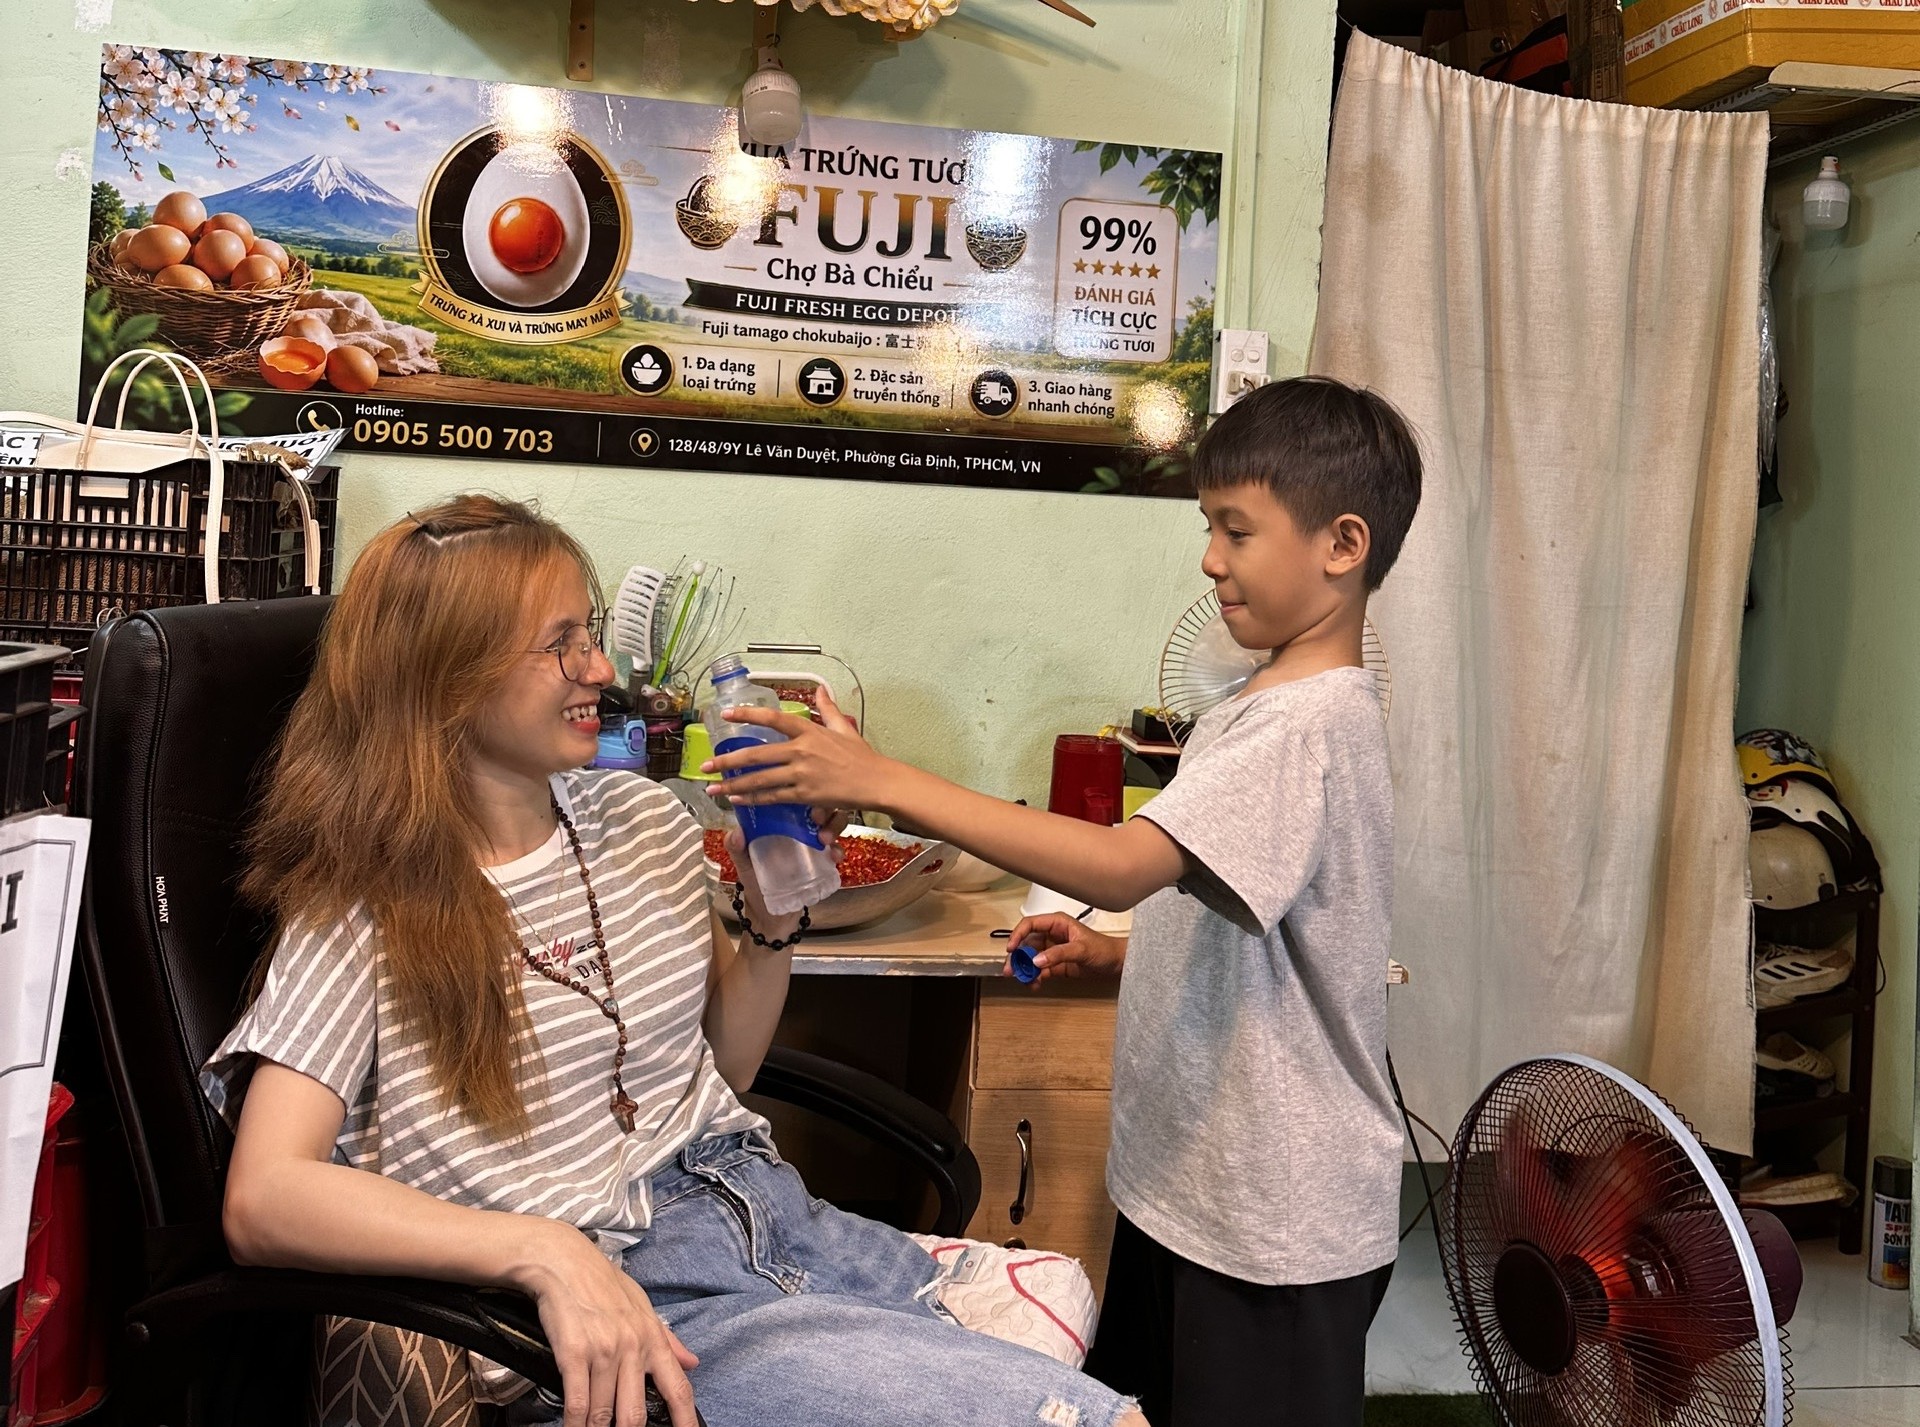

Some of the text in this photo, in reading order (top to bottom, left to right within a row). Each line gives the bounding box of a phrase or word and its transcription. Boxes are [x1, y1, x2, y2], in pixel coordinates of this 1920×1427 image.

[800, 145, 899, 180] TRỨNG
[753, 182, 957, 262] FUJI
[1079, 215, 1157, 256] 99%
[766, 258, 934, 292] Chợ Bà Chiểu
[735, 292, 958, 325] FUJI FRESH EGG DEPOT
[1074, 283, 1156, 307] ĐÁNH GIÁ
[429, 294, 467, 320] TRỨNG
[485, 318, 506, 332] XUI
[508, 320, 523, 334] VÀ
[525, 322, 565, 335] TRỨNG
[566, 316, 588, 332] MAY
[1072, 306, 1157, 333] TÍCH CỰC
[701, 319, 730, 338] Fuji
[733, 325, 789, 343] tamago
[792, 327, 873, 348] chokubaijo
[1123, 339, 1156, 353] TƯƠI
[682, 356, 756, 376] 1. Đa dạng
[854, 368, 923, 385] 2. Đặc sản
[682, 374, 757, 395] loại trứng
[853, 387, 941, 408] truyền thống
[1028, 380, 1113, 400] 3. Giao hàng
[355, 403, 405, 418] Hotline:
[1028, 400, 1116, 419] nhanh chóng
[353, 418, 554, 453] 0905 500 703
[668, 438, 1042, 474] 128/48/9Y Lê Văn Duyệt, Phường Gia Định, TPHCM, VN
